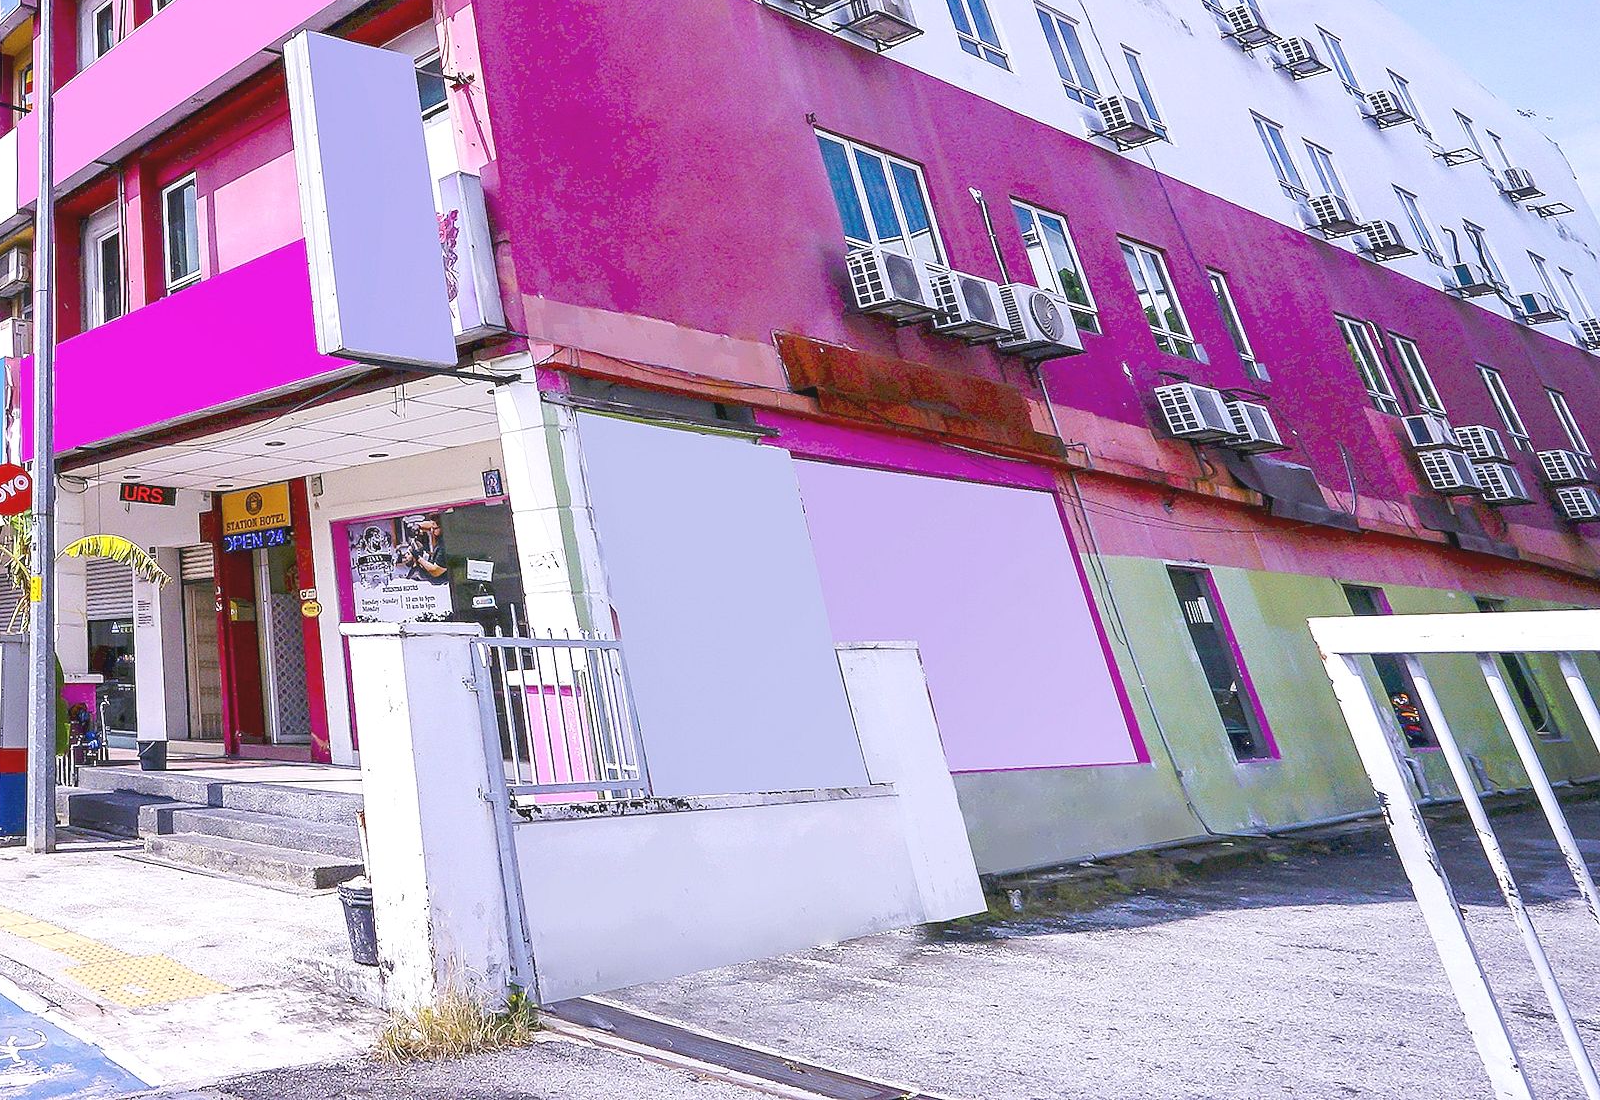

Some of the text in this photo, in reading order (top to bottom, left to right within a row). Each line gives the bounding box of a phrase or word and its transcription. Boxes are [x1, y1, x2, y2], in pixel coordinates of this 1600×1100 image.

[124, 485, 164, 504] URS
[226, 513, 286, 532] STATION HOTEL
[266, 529, 286, 547] 24
